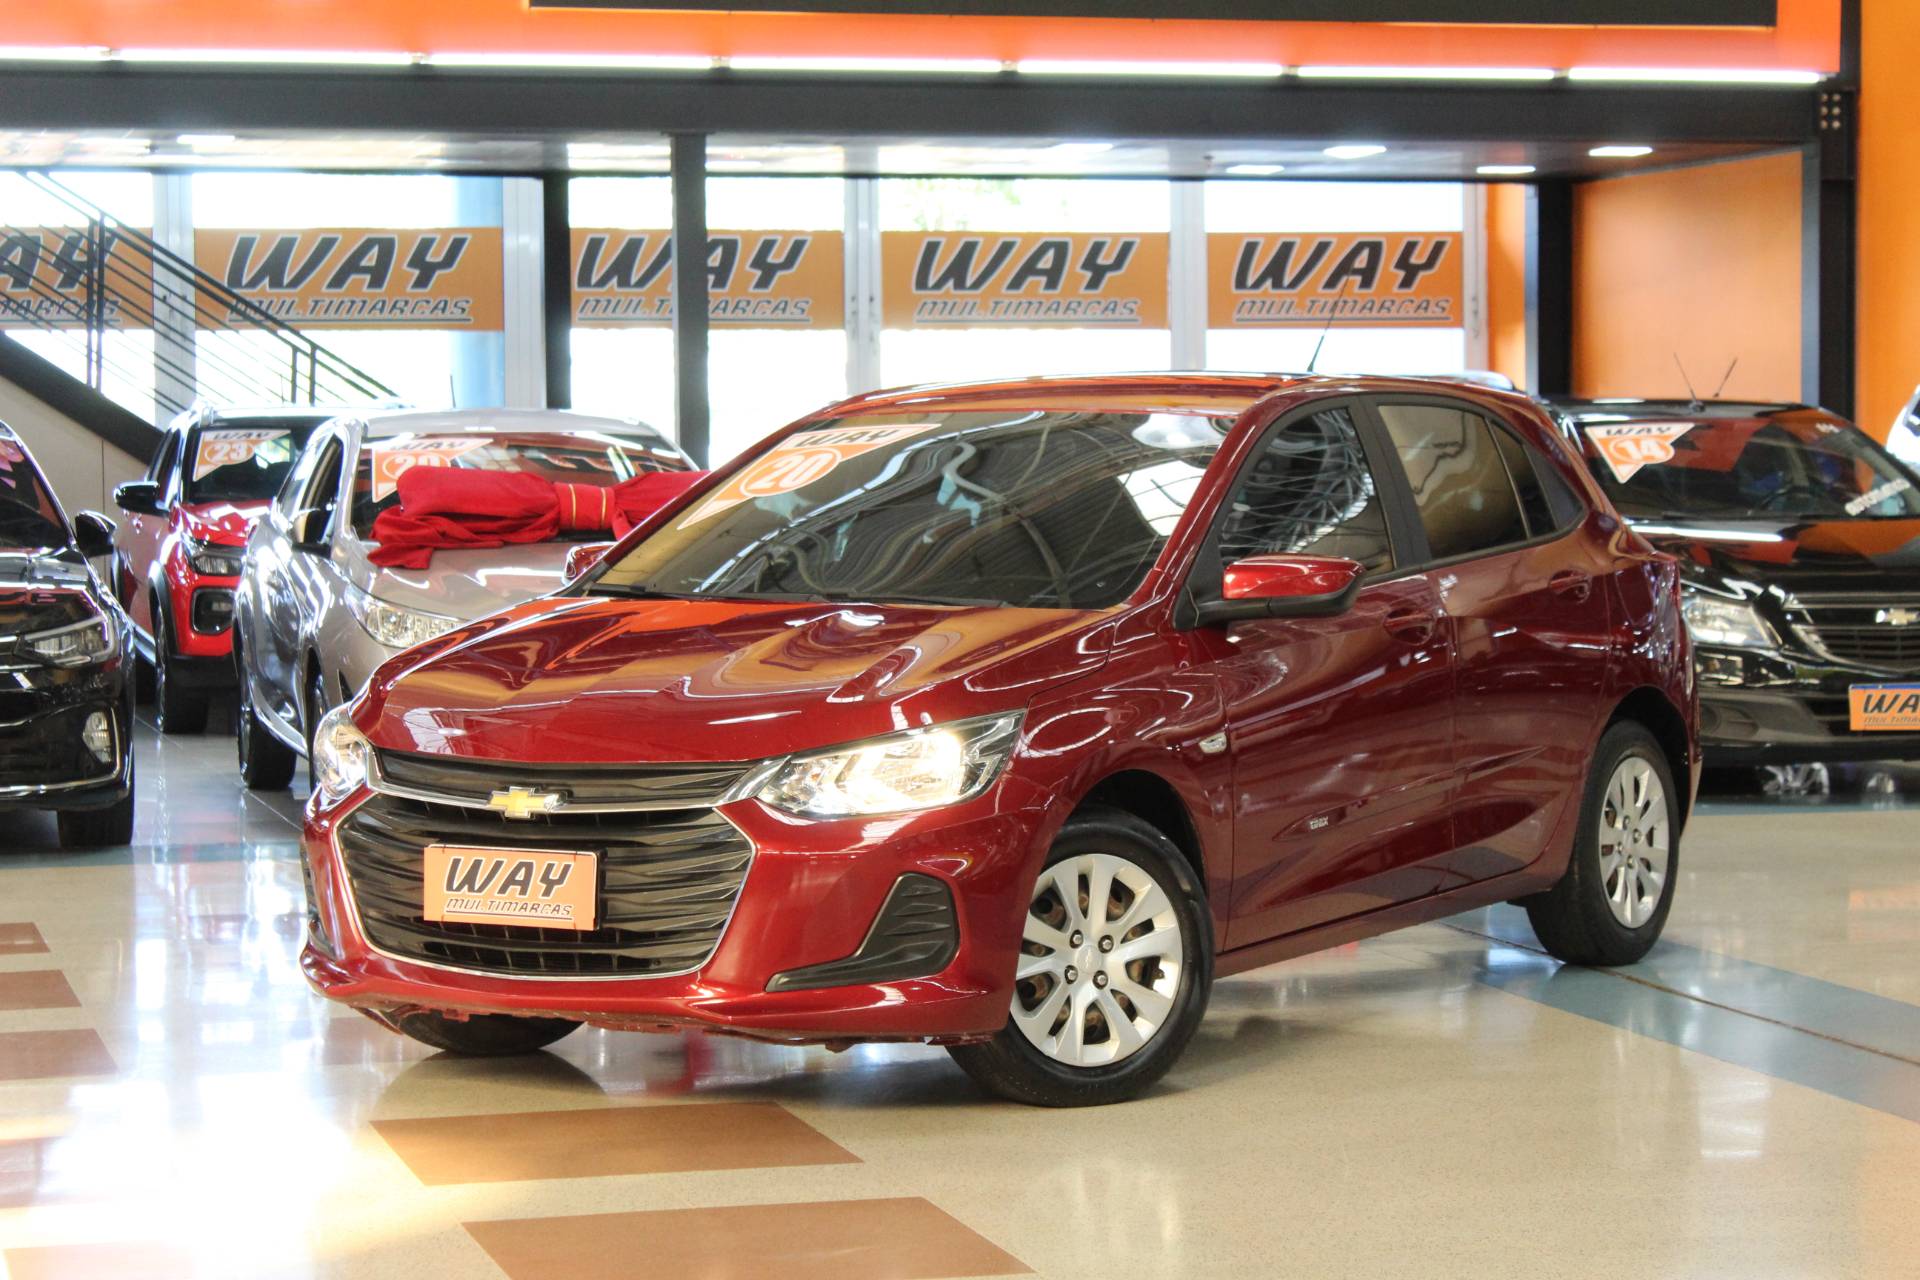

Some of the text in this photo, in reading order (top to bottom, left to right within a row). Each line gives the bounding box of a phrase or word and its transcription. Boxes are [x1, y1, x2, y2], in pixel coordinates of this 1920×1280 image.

[225, 236, 470, 290] WAY
[914, 239, 1138, 292] WAY
[1234, 240, 1449, 291] WAY
[579, 299, 810, 316] MULTARCAS
[916, 300, 1140, 316] MULTIMARCAS
[1236, 300, 1450, 315] MULTIMARCAS
[793, 429, 900, 448] WAY
[208, 442, 248, 461] 23
[1616, 440, 1666, 460] 14
[747, 453, 834, 490] 20
[445, 857, 573, 898] WAY
[446, 898, 573, 916] MULTIMARCAS
